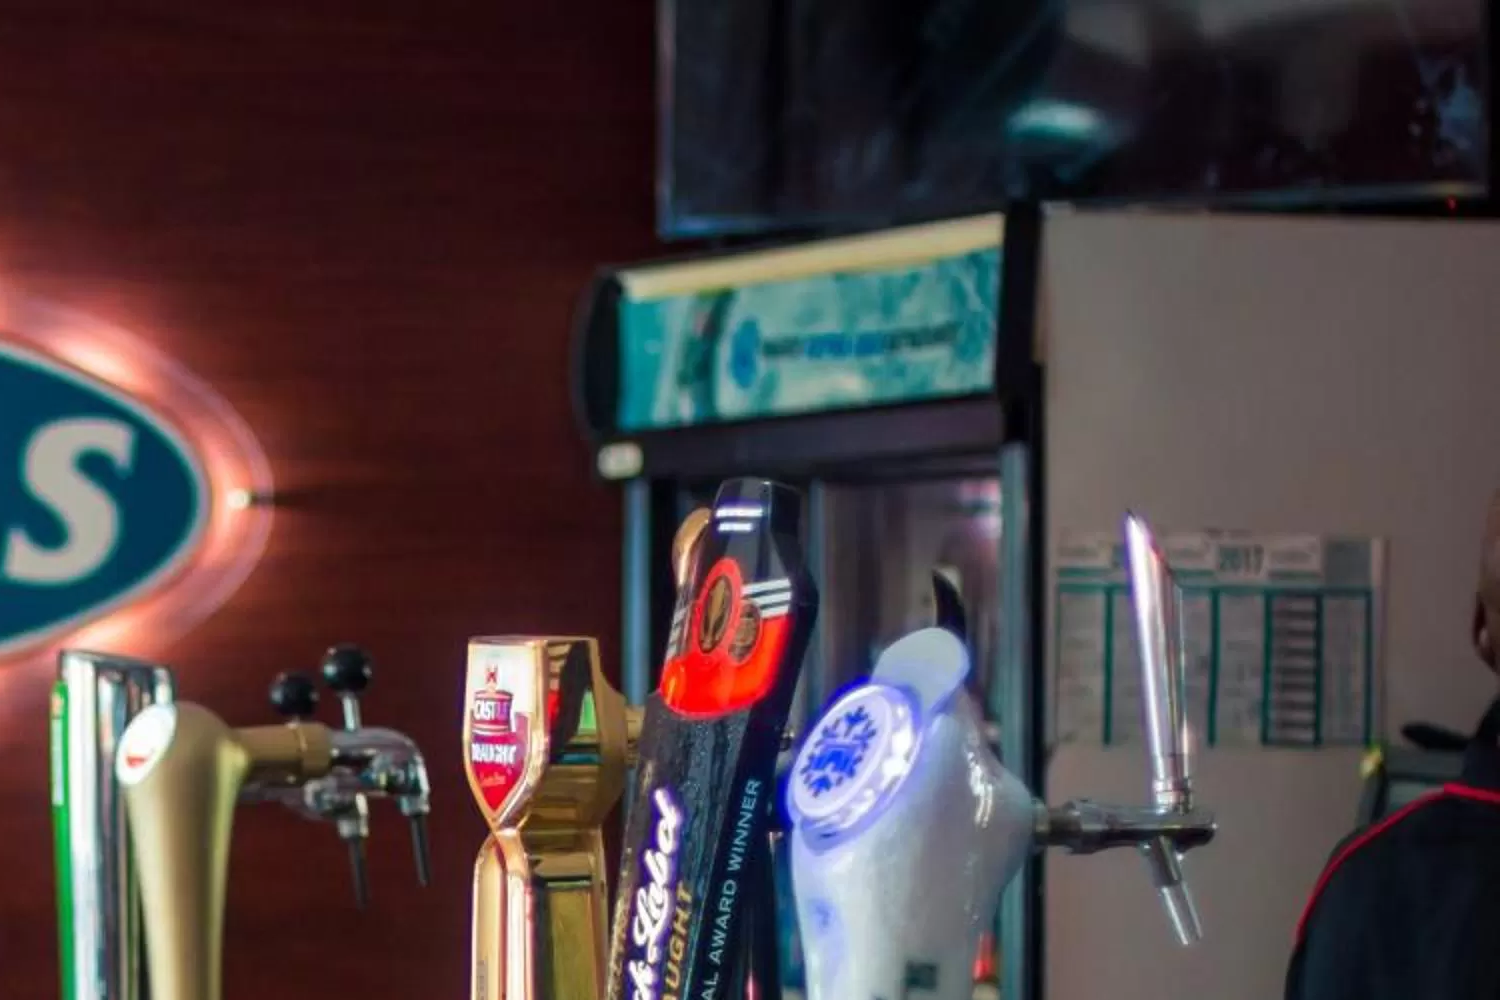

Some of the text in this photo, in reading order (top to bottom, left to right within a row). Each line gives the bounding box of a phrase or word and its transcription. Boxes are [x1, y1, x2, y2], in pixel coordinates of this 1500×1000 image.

[633, 787, 678, 964] Label
[708, 878, 738, 965] AWARD
[727, 779, 763, 872] WINNER
